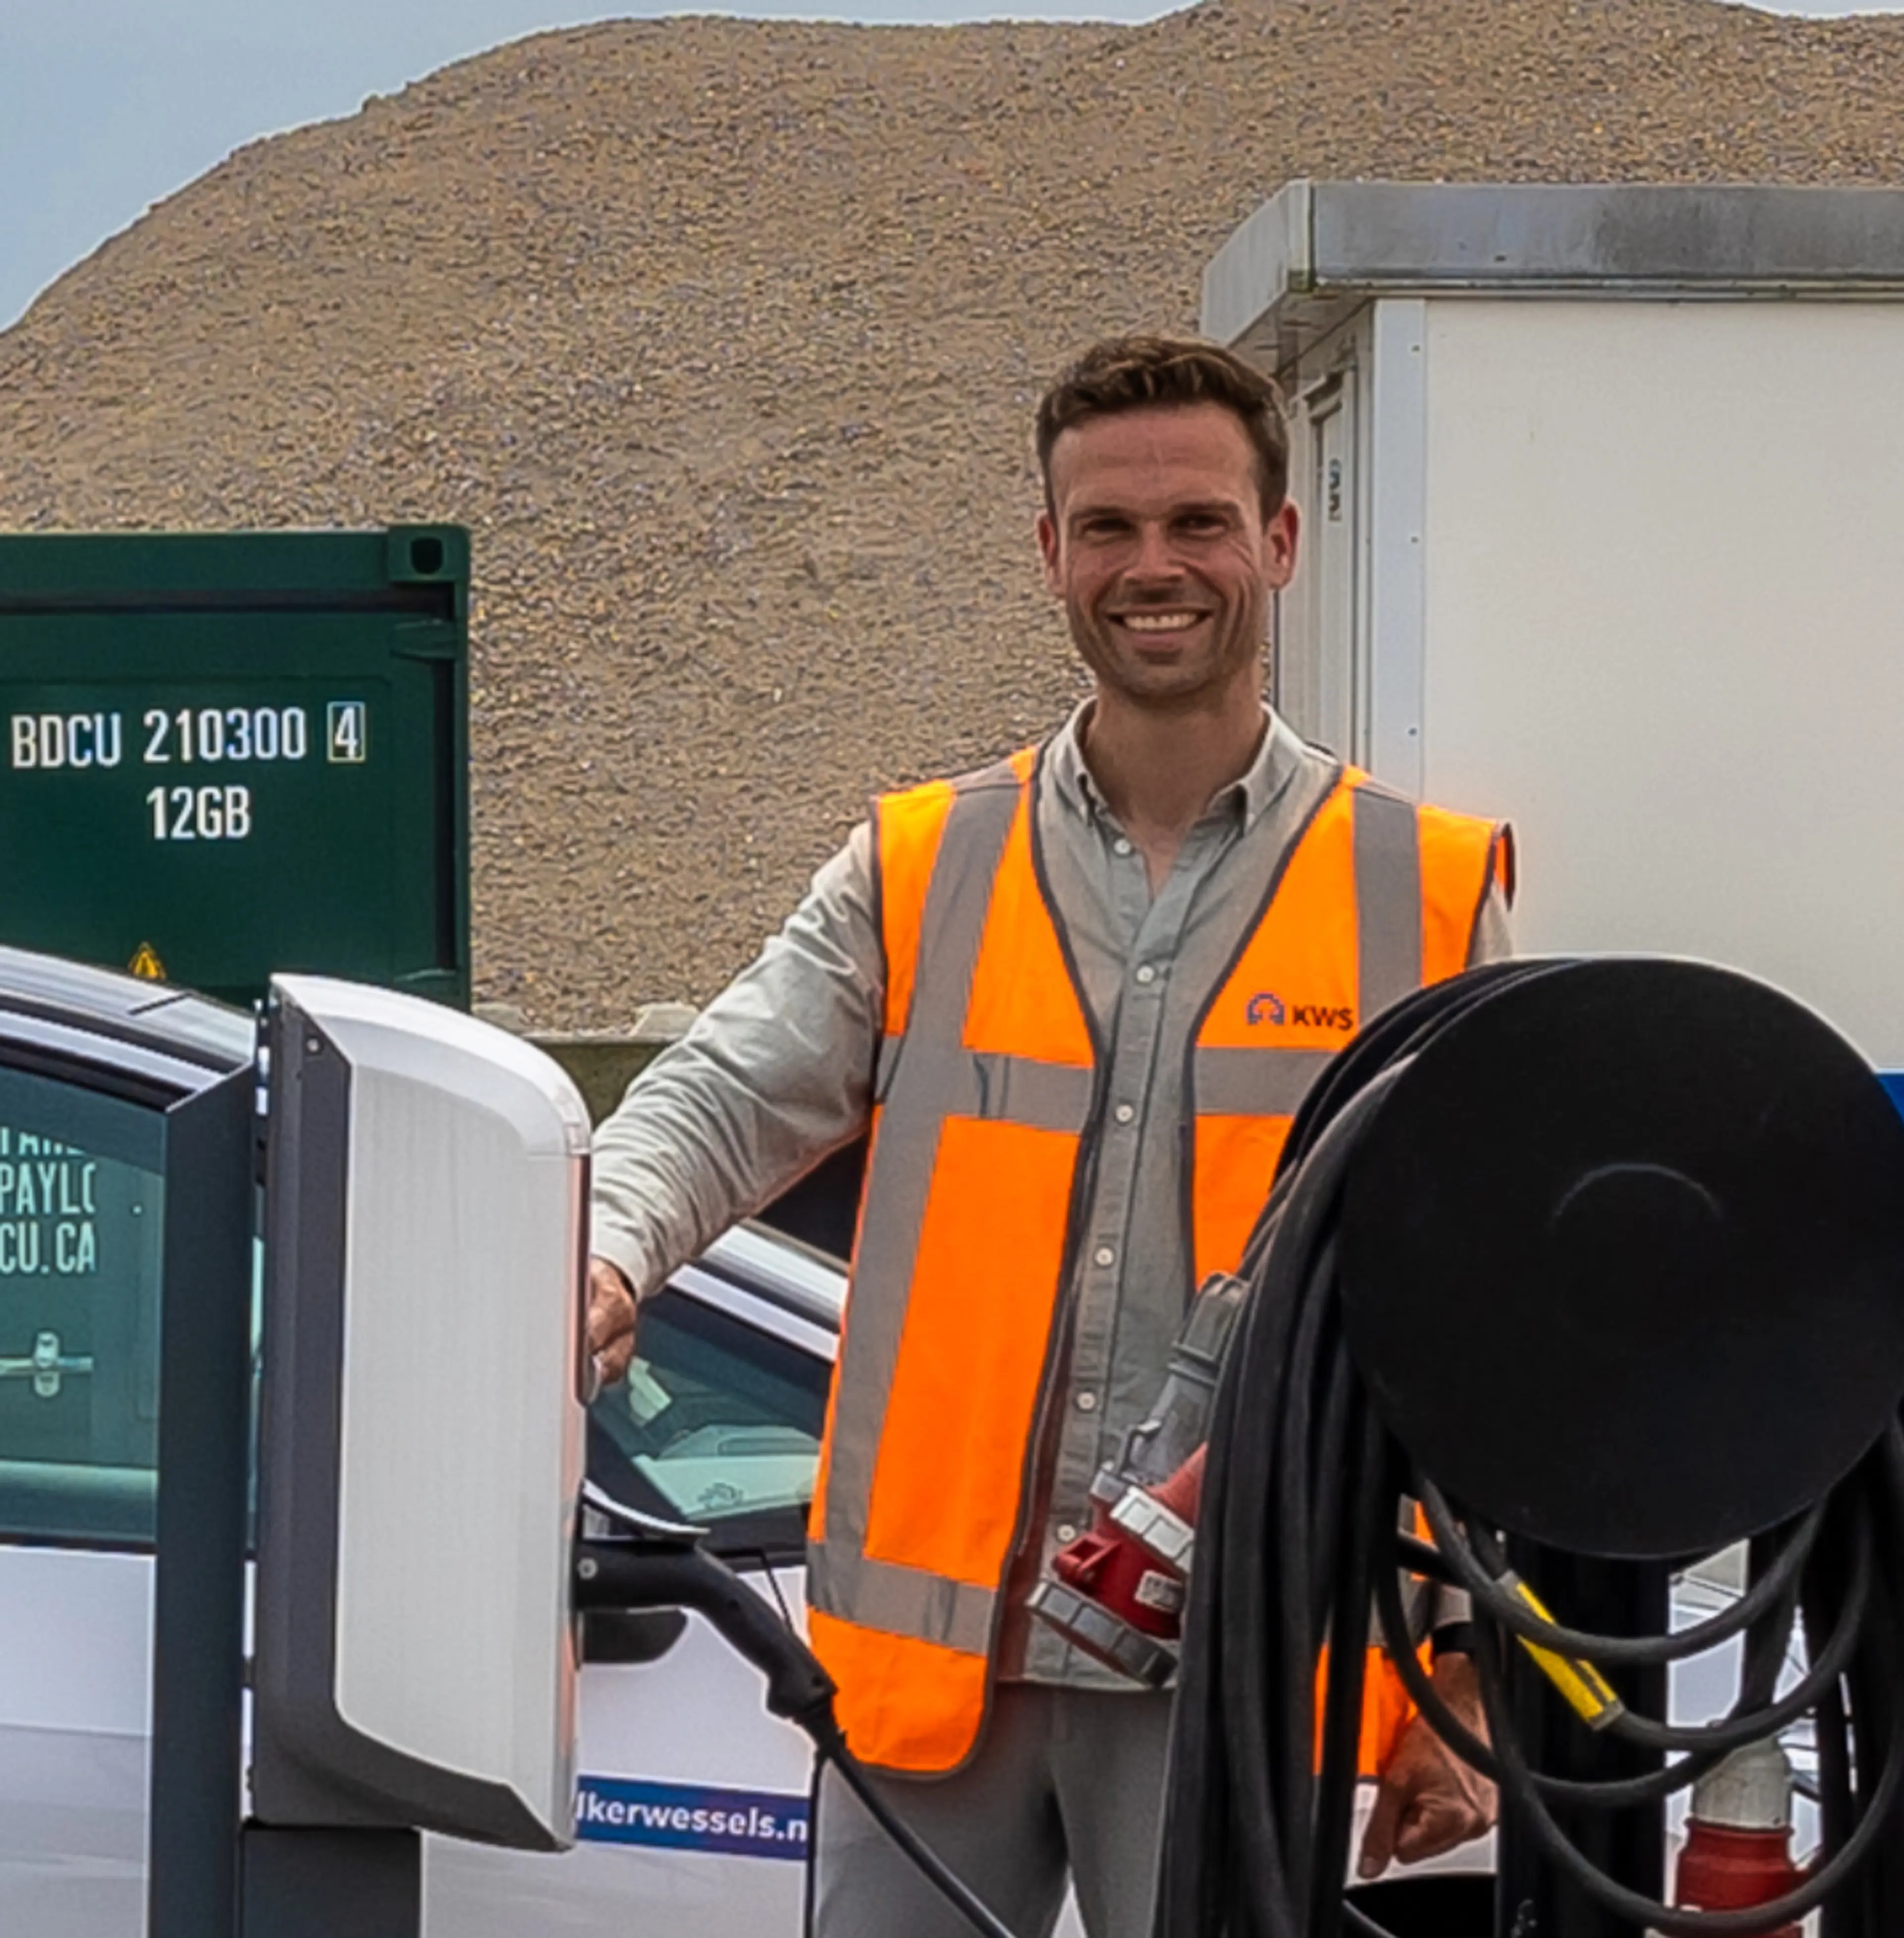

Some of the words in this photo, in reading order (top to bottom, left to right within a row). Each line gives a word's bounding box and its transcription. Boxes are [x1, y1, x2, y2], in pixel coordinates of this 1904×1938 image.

[11, 713, 121, 768] BDCU
[143, 707, 306, 763] 210300
[334, 706, 358, 759] 4
[146, 785, 250, 840] 12GB
[1292, 1005, 1354, 1031] KWS
